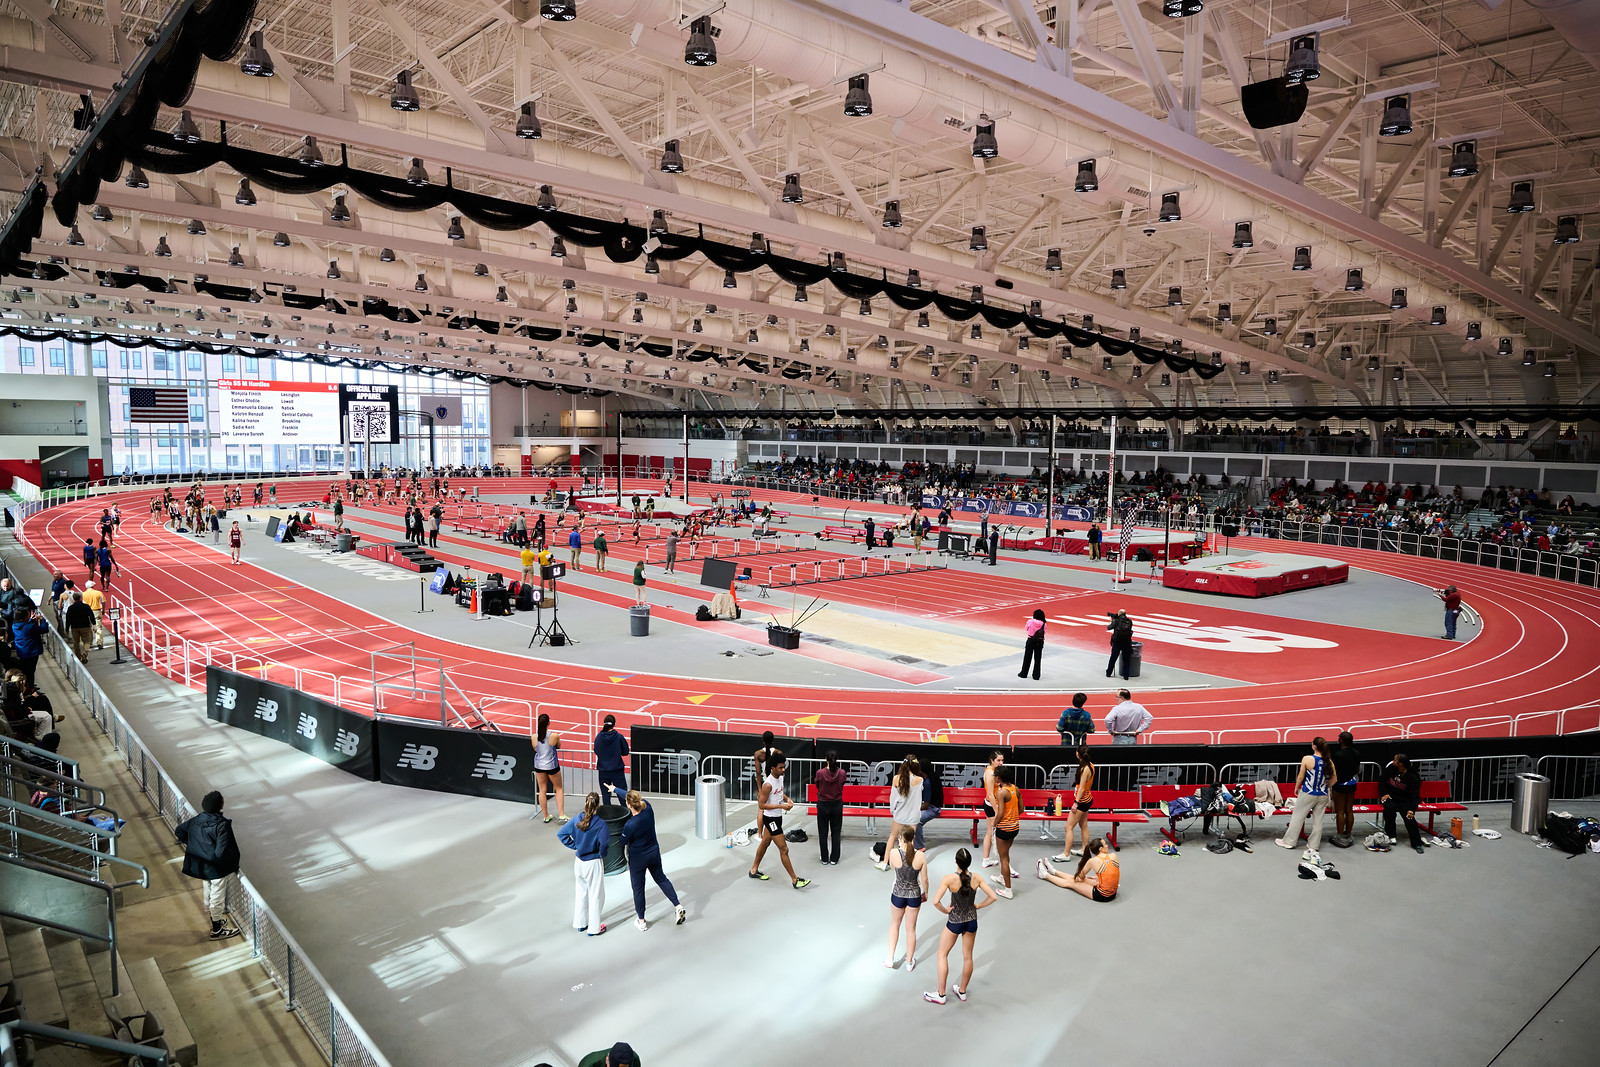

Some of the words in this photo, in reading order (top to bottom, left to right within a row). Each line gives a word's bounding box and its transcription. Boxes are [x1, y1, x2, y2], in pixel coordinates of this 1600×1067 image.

[347, 385, 371, 393] OFFICIAL
[1401, 446, 1408, 454] 11
[1195, 577, 1209, 585] GILL
[216, 685, 238, 710] NB
[254, 697, 279, 723] NB
[297, 712, 319, 740] NB
[334, 728, 360, 757] NB
[397, 743, 439, 771] NB
[471, 752, 517, 781] NB
[652, 748, 702, 776] NB
[844, 761, 894, 786] NB
[1136, 765, 1183, 791] NB
[1417, 759, 1459, 782] NB
